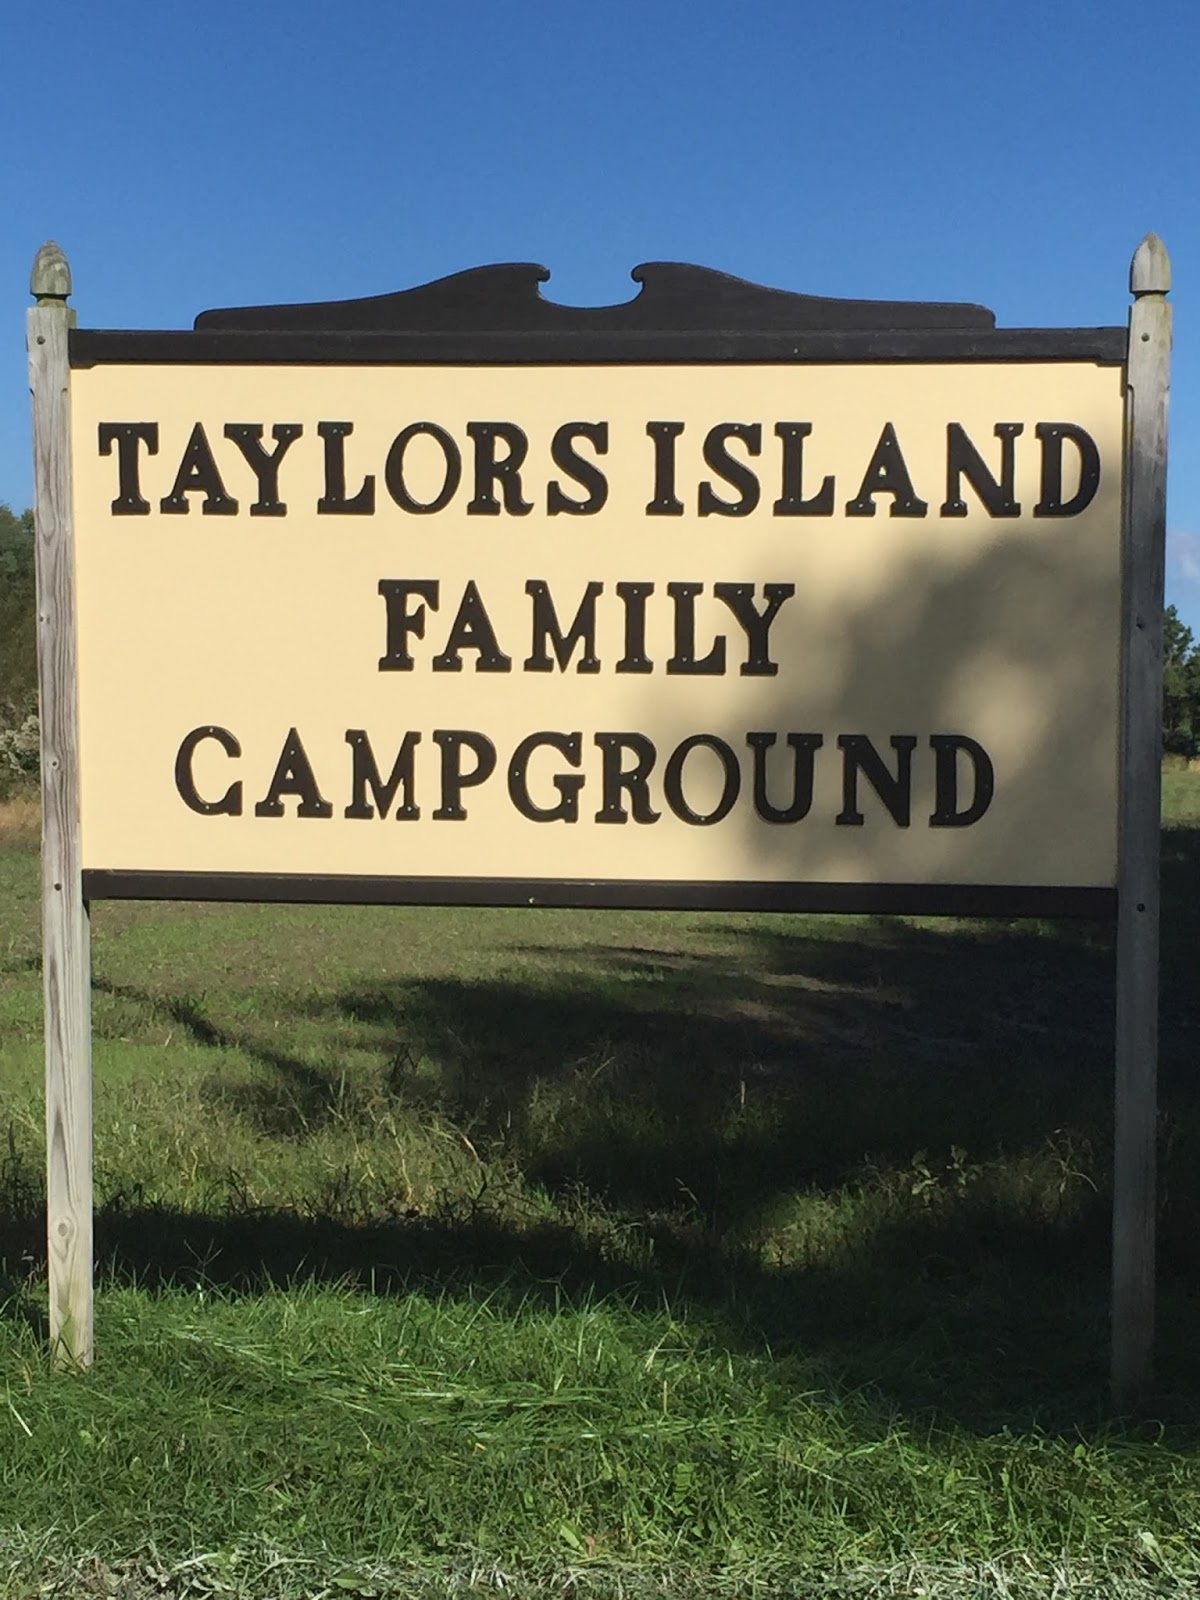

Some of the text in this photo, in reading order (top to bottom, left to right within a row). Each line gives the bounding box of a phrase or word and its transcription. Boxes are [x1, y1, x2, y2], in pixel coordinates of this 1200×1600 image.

[98, 421, 1101, 519] TAYLORS ISLAND
[378, 579, 795, 677] FAMILY
[175, 726, 995, 829] CAMPGROUND
